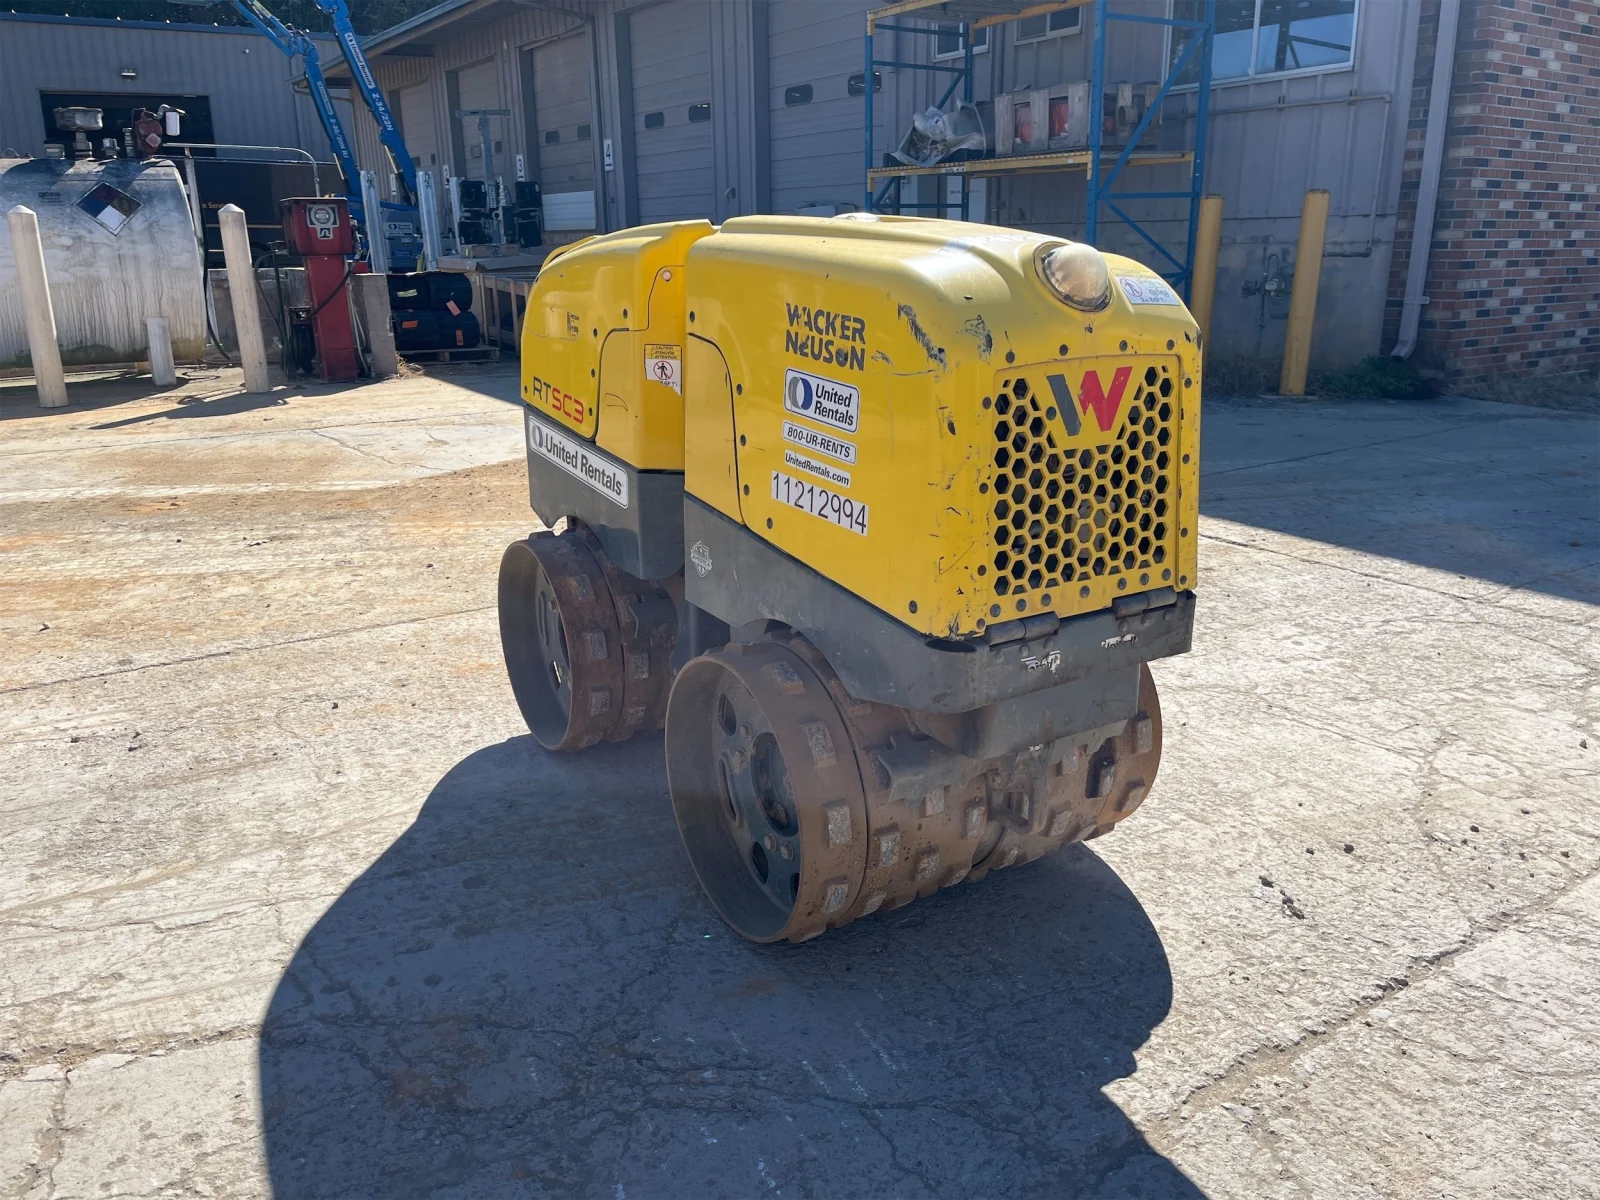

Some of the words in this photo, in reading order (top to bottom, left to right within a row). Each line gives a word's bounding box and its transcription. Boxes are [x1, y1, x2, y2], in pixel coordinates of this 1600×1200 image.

[350, 43, 362, 63] United
[360, 64, 373, 87] Rentals
[785, 302, 866, 345] WACKER
[785, 329, 866, 372] NEUSON
[533, 376, 584, 424] RTSC3
[814, 400, 854, 426] Rentals
[815, 383, 852, 408] United
[787, 426, 851, 458] 800-UR-RENTS
[544, 433, 578, 470] United
[580, 453, 622, 496] Rentals
[785, 452, 849, 486] UnitedRentals.com
[773, 472, 867, 534] 11212994
